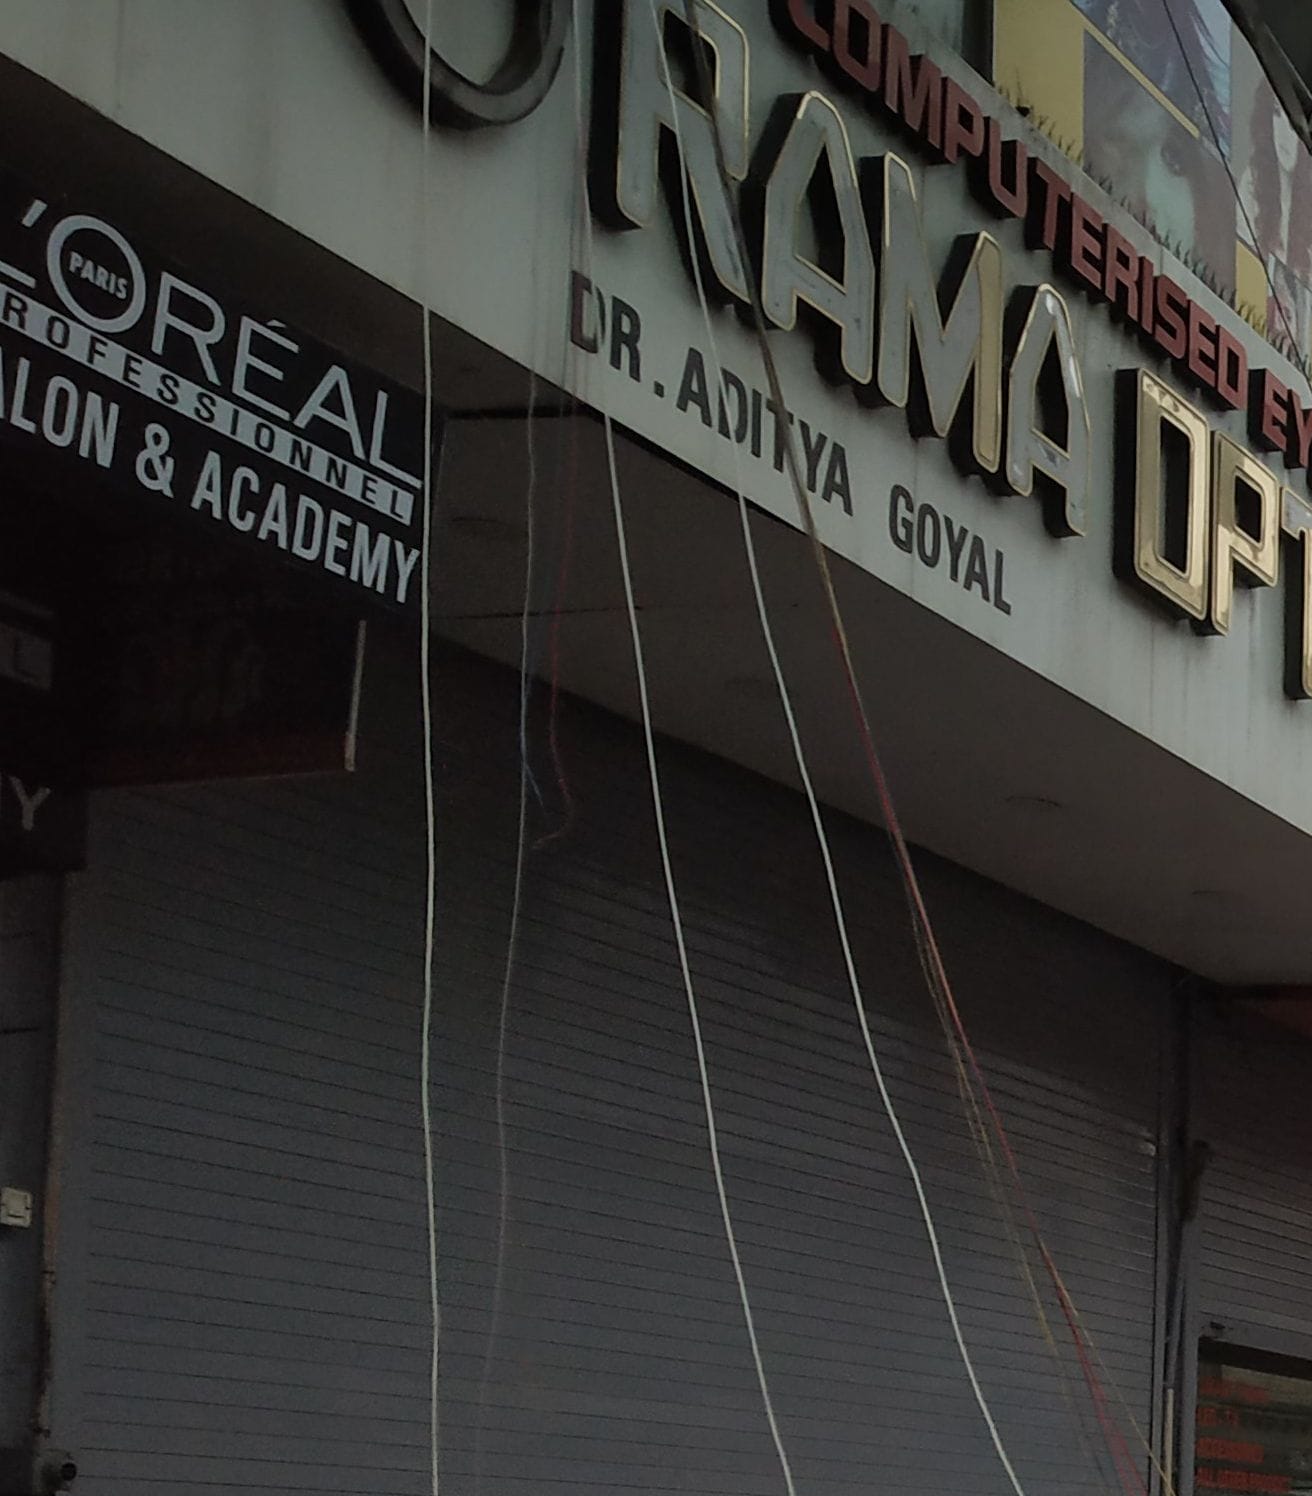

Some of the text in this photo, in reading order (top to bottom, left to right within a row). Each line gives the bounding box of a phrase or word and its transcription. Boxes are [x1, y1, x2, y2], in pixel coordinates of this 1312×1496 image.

[68, 249, 129, 302] PARIS
[0, 345, 421, 605] LON & ACADEMY
[887, 482, 1012, 617] GOYAL
